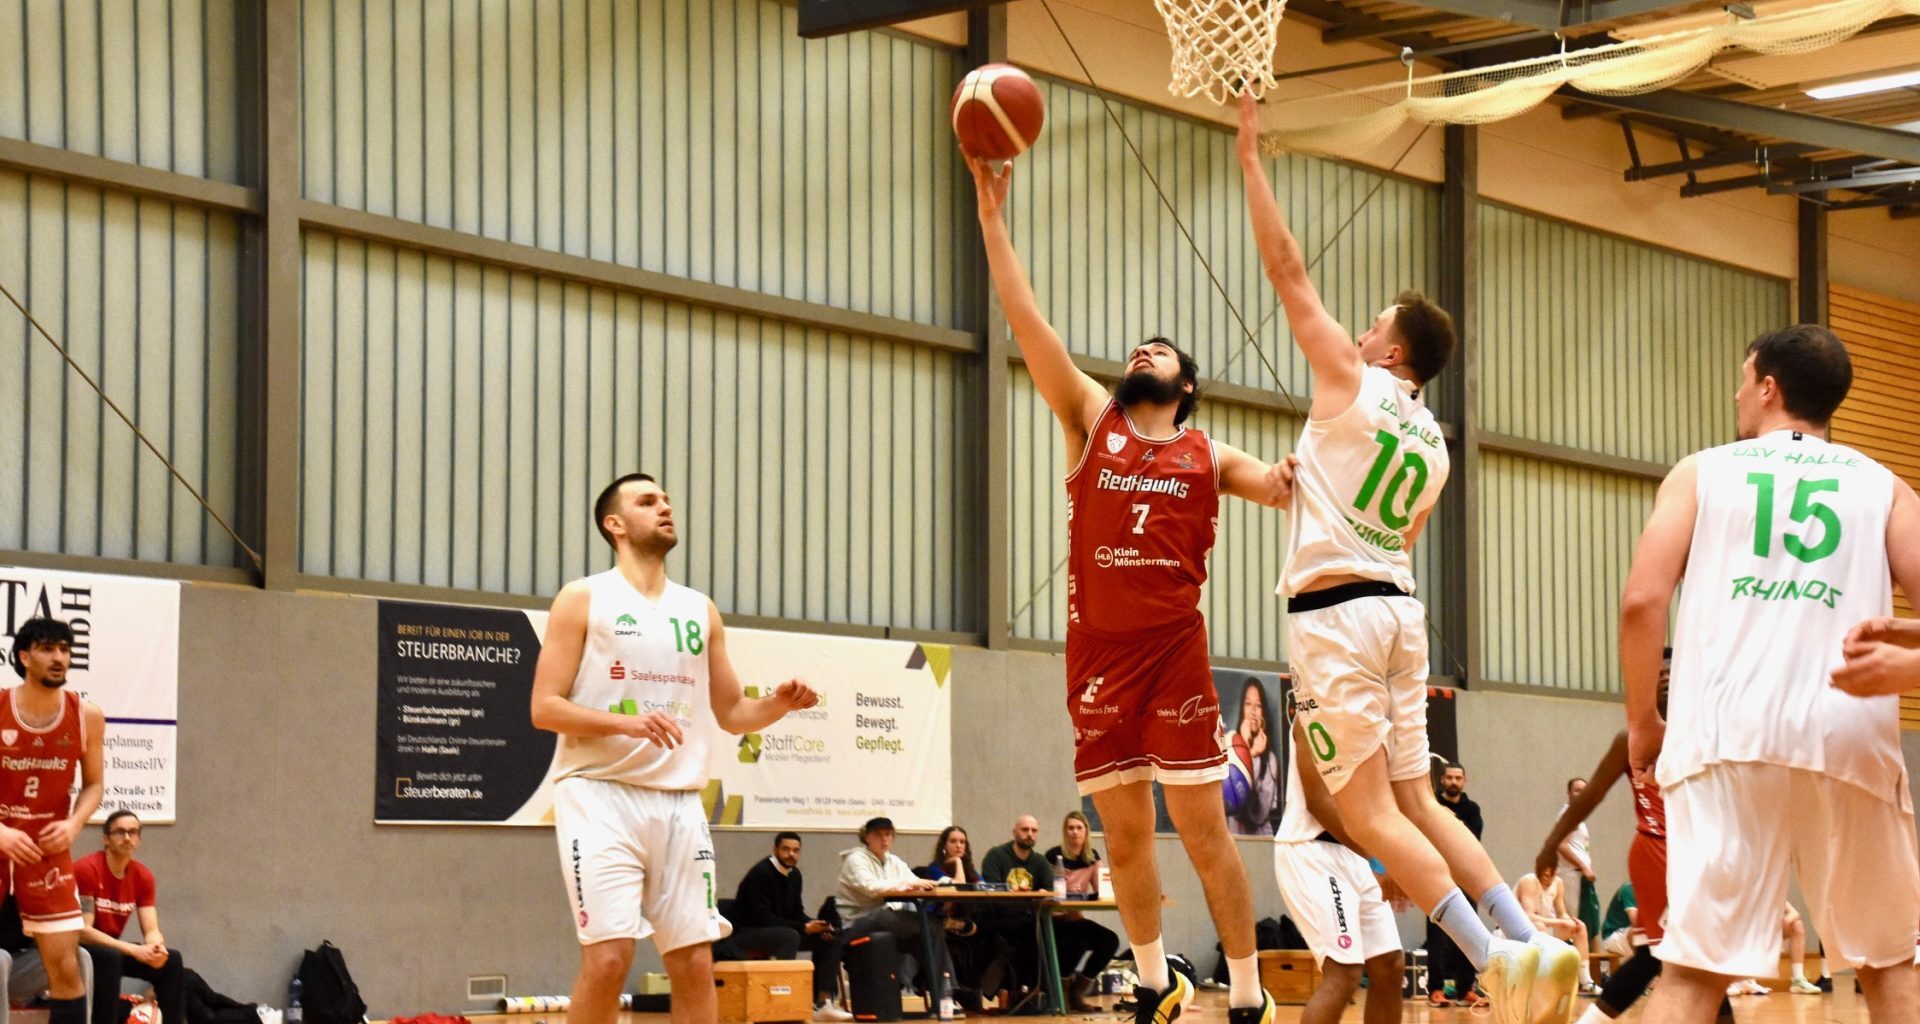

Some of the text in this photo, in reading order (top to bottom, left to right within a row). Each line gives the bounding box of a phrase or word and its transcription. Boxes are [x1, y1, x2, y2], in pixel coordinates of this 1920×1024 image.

[1733, 448, 1861, 468] USV HALLE
[1353, 429, 1428, 530] 10
[1131, 503, 1150, 534] 7
[1747, 472, 1842, 563] 15
[1114, 548, 1139, 557] Klein
[1731, 576, 1842, 609] RHINOS
[398, 624, 510, 641] BEREIT FÜR EINEN JOB IN DER
[669, 617, 704, 655] 18
[397, 640, 520, 664] STEUERBRANCHE?
[856, 692, 904, 708] Bewusst.
[856, 714, 898, 732] Bewegt.
[103, 735, 153, 751] uplanung
[765, 733, 825, 752] StaffCare
[856, 736, 904, 754] Gepflegt.
[24, 776, 40, 798] 2
[114, 785, 145, 797] Straße
[150, 786, 165, 797] 137
[403, 785, 483, 799] steuerberaten.de
[118, 800, 163, 811] Delitzsch
